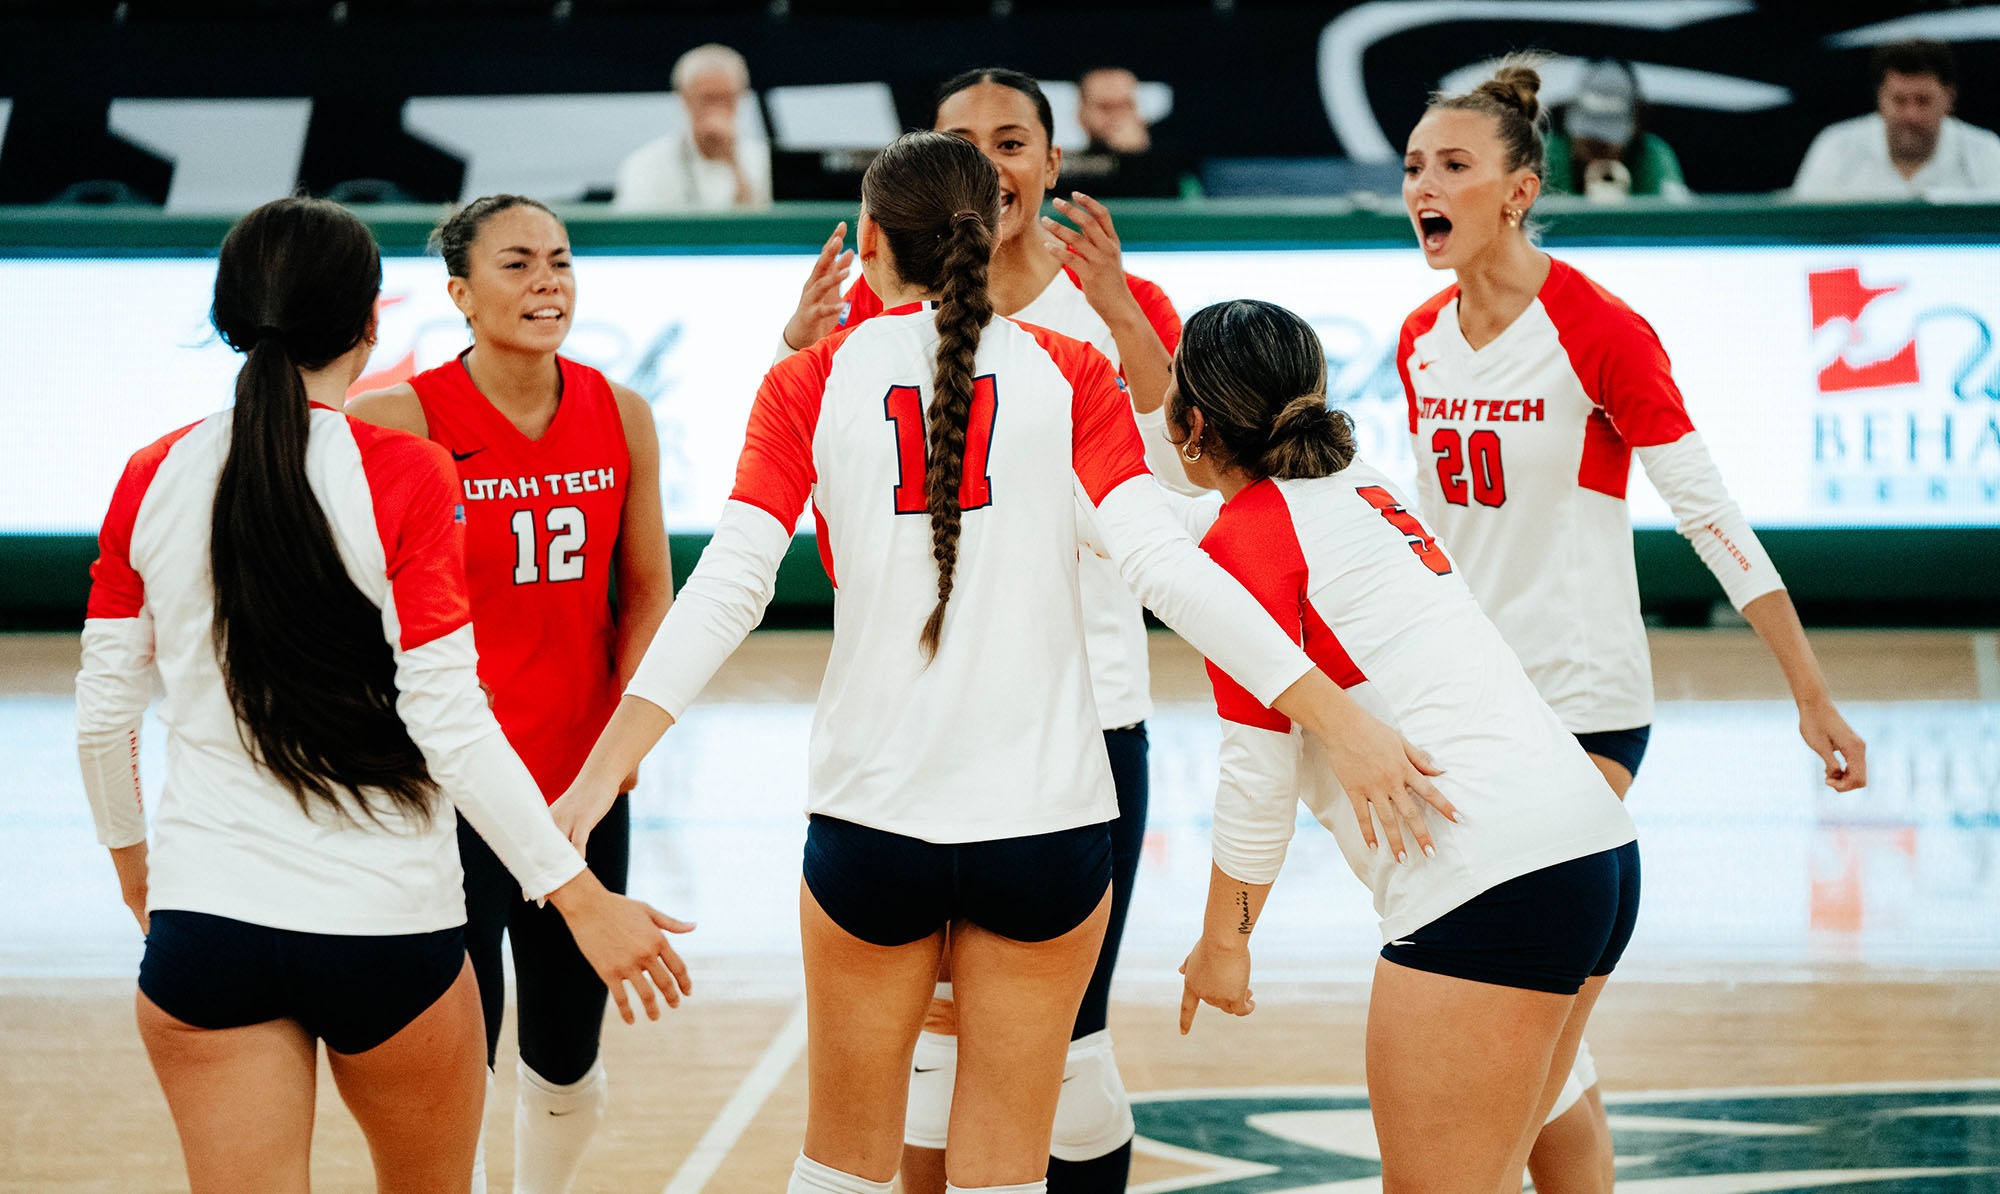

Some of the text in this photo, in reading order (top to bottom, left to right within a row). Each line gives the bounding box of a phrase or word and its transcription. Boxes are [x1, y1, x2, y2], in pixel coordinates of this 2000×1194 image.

[1472, 398, 1544, 421] TECH
[463, 467, 615, 500] UTAH TECH
[1431, 428, 1507, 508] 20
[511, 505, 588, 586] 12
[1354, 485, 1453, 576] 5
